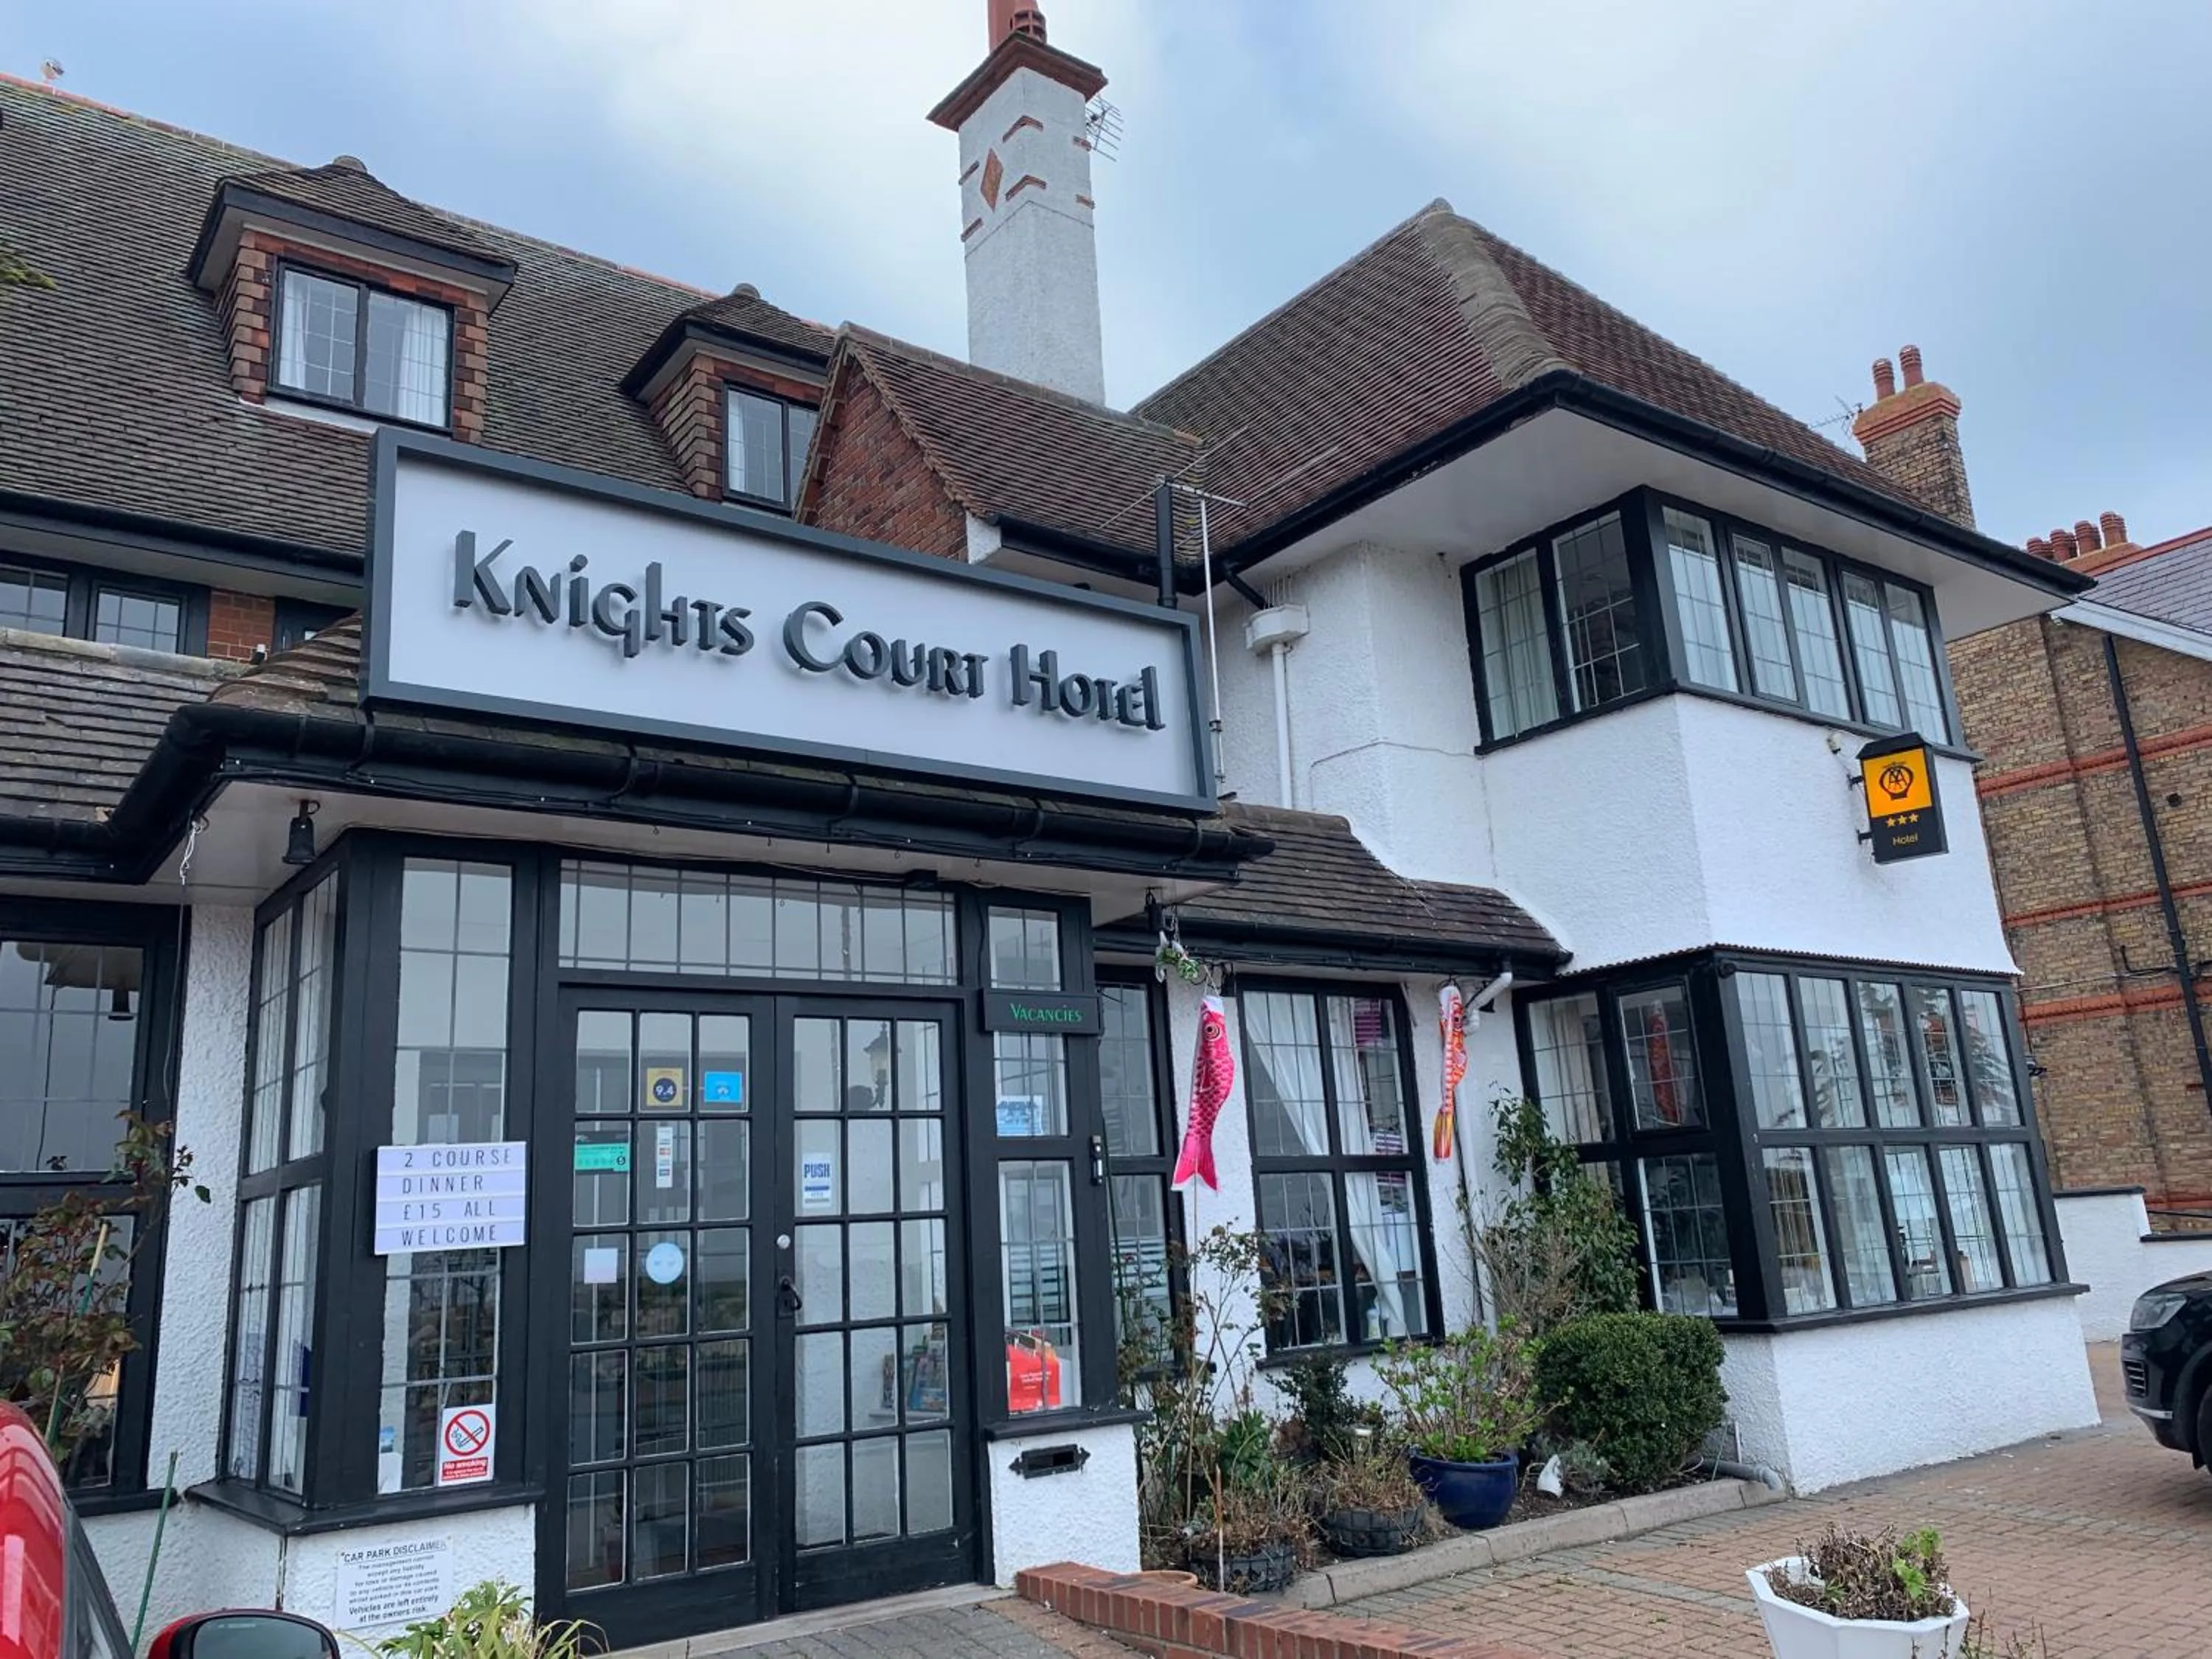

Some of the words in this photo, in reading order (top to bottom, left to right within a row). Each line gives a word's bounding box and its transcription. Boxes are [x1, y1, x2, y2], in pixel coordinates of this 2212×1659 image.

[1892, 832, 1919, 846] Hotel
[655, 1085, 674, 1096] 9.4
[405, 1152, 413, 1167] 2
[432, 1148, 511, 1167] COURSE
[804, 1163, 830, 1178] PUSH
[402, 1175, 484, 1194] DINNER
[403, 1203, 441, 1220] £15
[464, 1200, 496, 1217] ALL
[401, 1225, 496, 1246] WELCOME
[344, 1551, 364, 1563] CAR
[366, 1548, 392, 1559] PARK
[393, 1540, 447, 1555] DISCLAIMER
